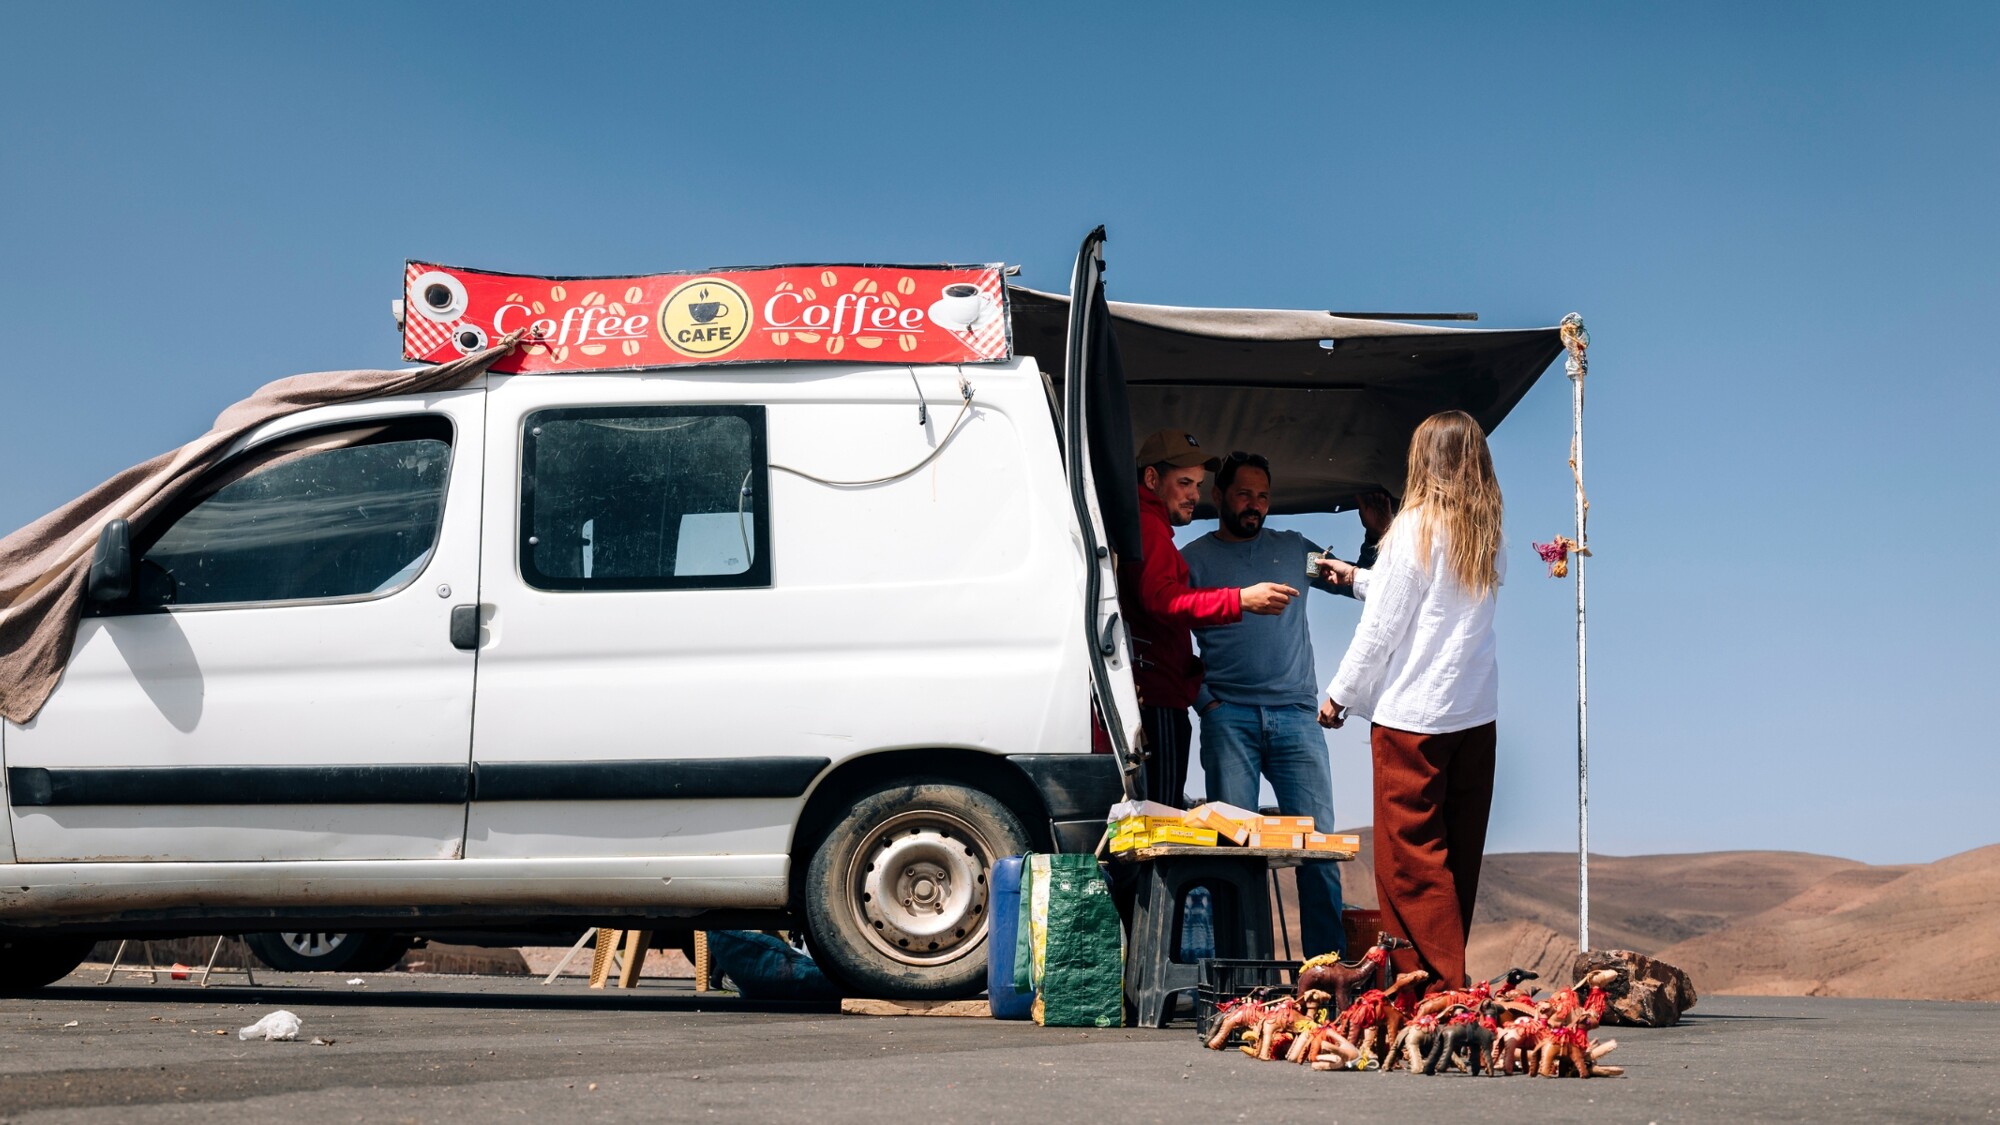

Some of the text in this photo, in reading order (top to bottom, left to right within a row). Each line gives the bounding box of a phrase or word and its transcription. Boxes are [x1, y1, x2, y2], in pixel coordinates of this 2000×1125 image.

[493, 304, 649, 346] Coffee
[678, 326, 732, 343] CAFE
[764, 292, 924, 335] Coffee
